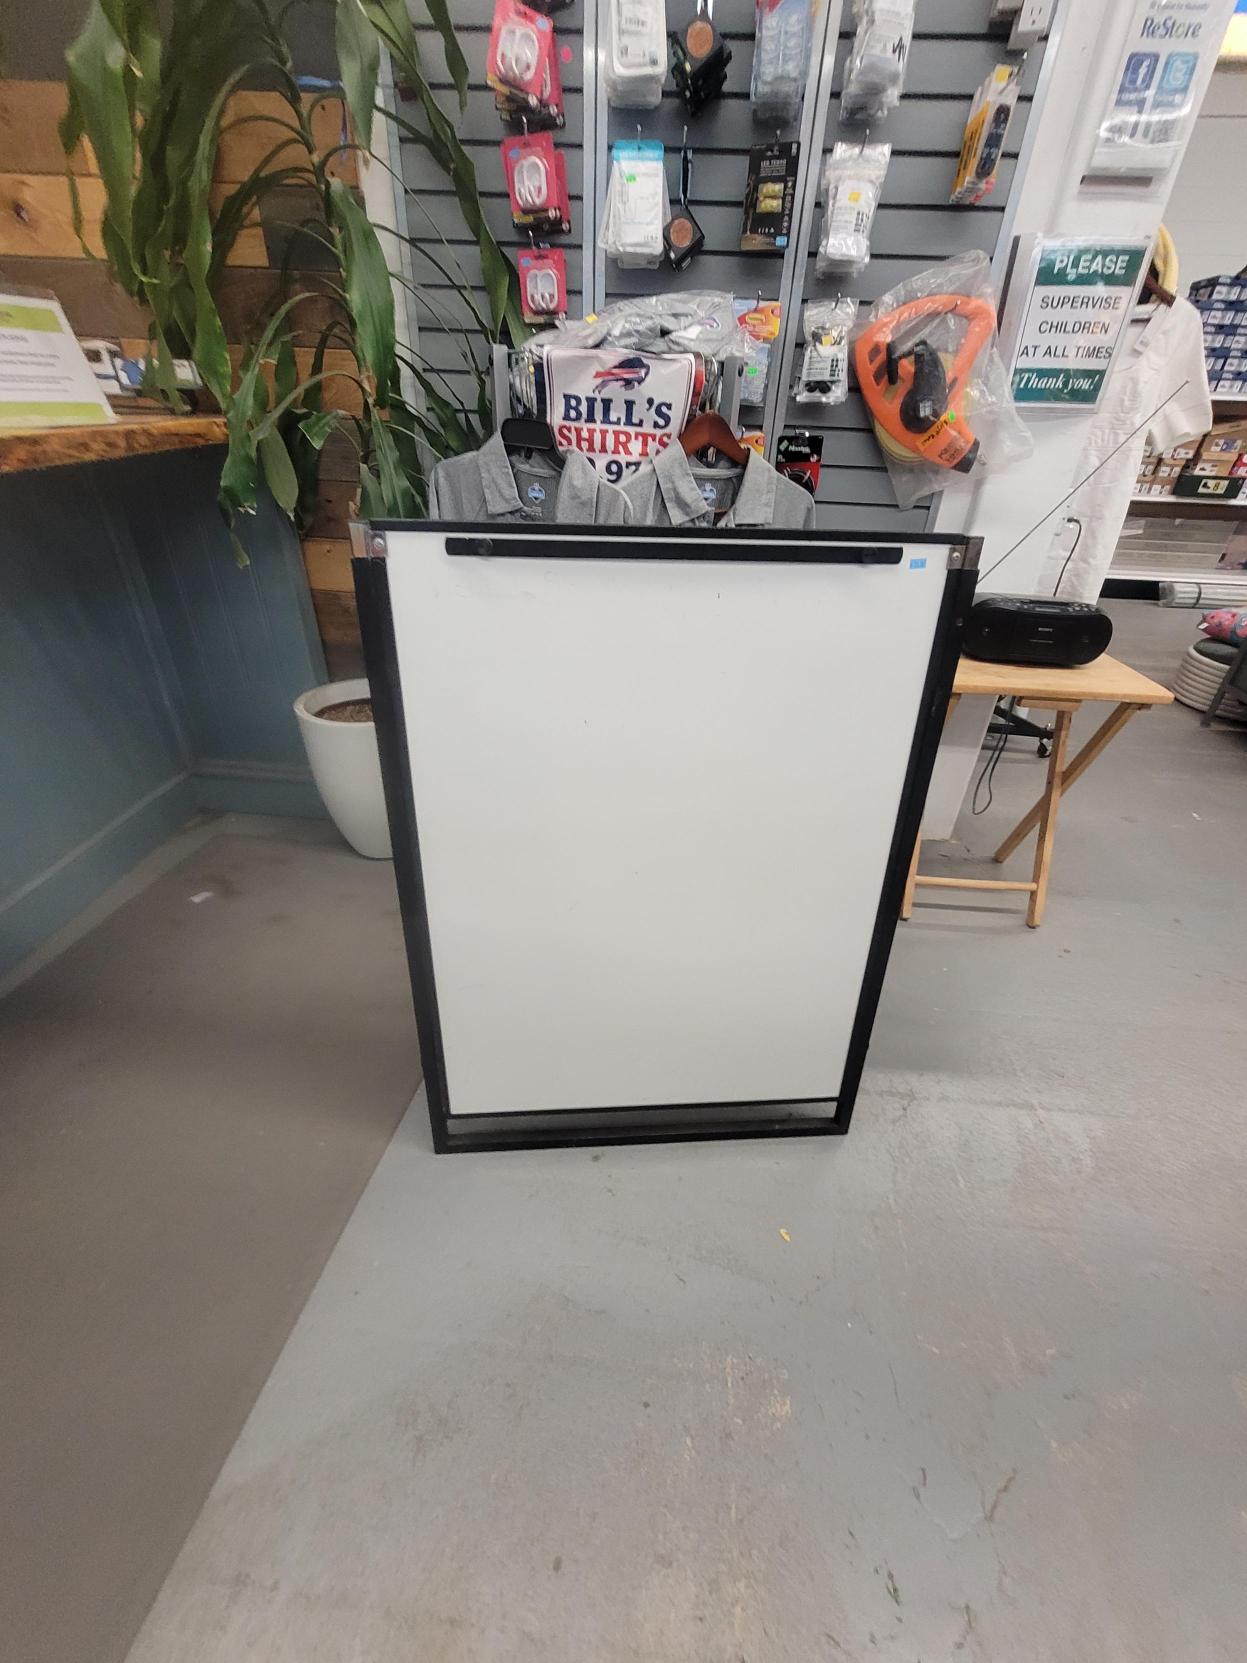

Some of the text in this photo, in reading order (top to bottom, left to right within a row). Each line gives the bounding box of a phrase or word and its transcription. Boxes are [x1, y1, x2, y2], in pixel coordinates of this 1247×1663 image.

[1140, 16, 1202, 39] ReStore
[1053, 254, 1130, 276] PLEASE
[1039, 294, 1123, 311] SUPERVISE
[1038, 320, 1111, 335] CHILDREN
[1020, 345, 1115, 360] AT ALL TIMES
[1019, 372, 1100, 393] Thank you!
[562, 393, 673, 430] BILL'S
[557, 424, 673, 458] SHIRTS
